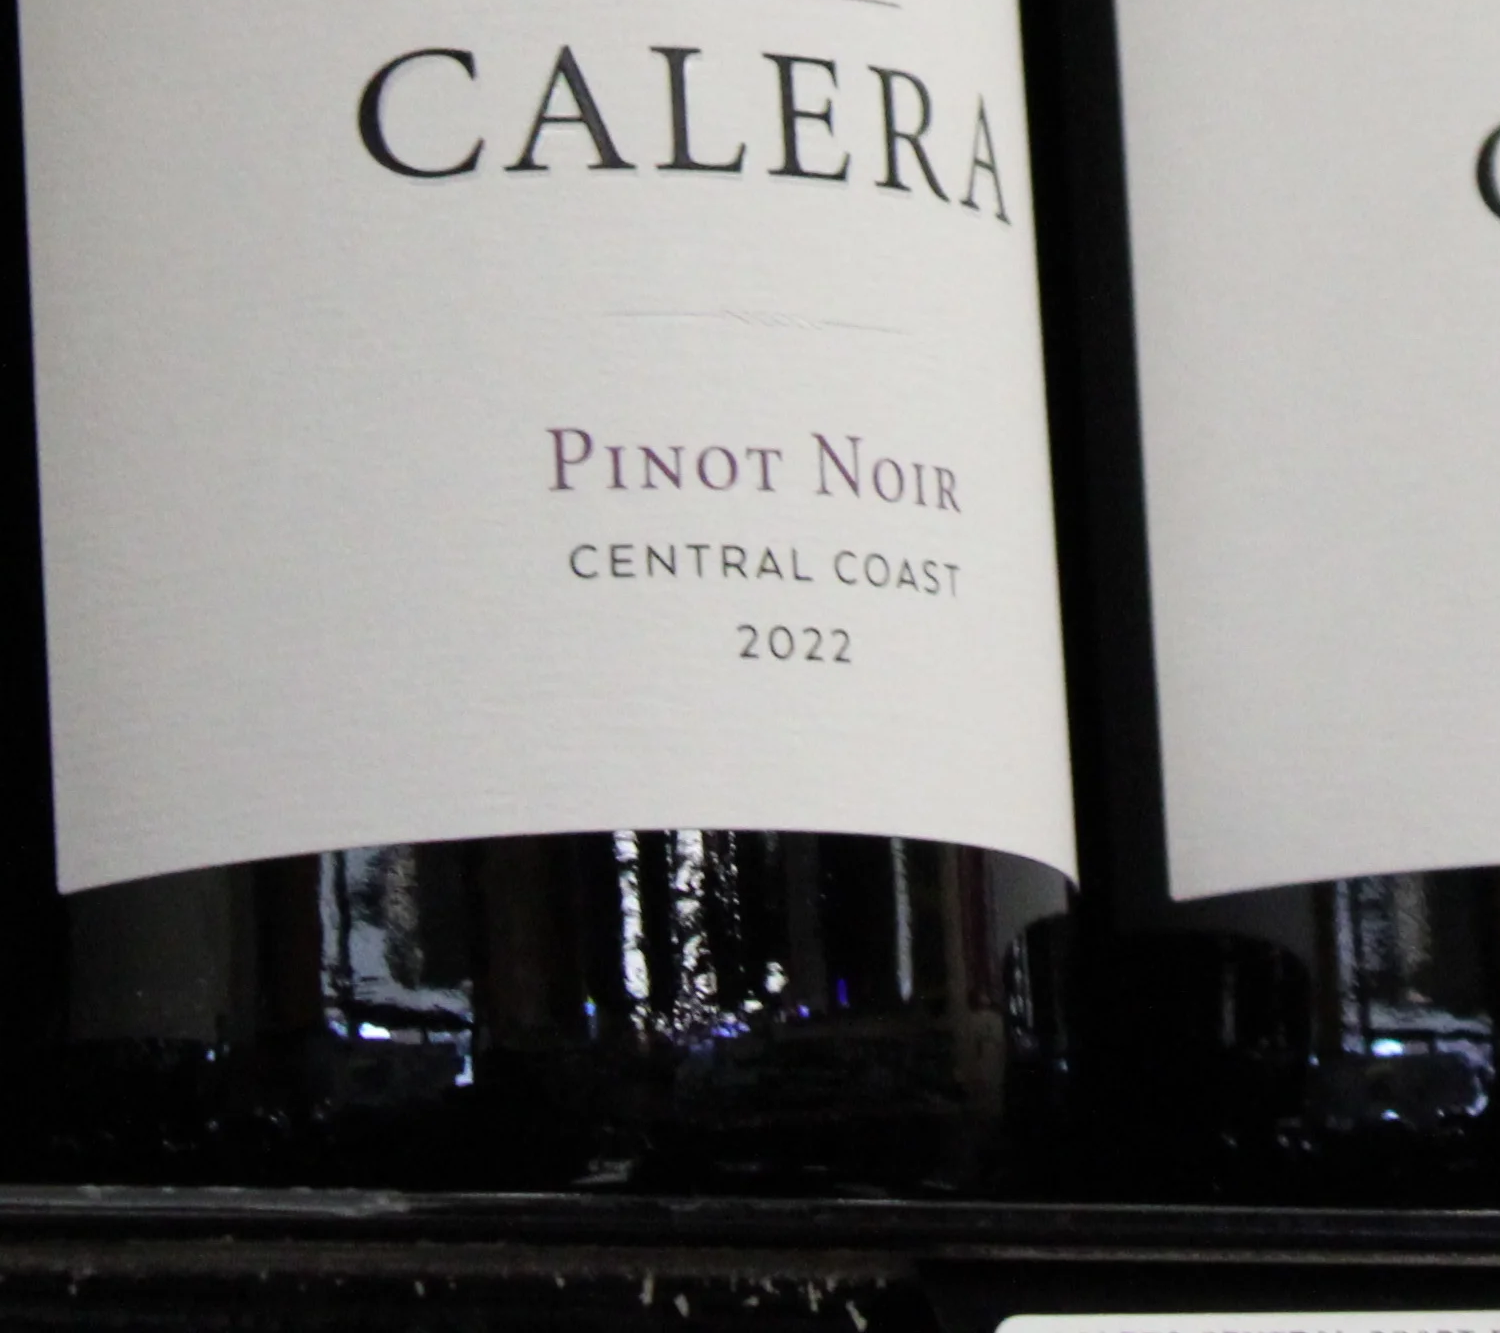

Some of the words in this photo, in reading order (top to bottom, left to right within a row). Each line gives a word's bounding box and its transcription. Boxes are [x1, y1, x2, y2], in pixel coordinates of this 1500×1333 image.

[355, 44, 1014, 228] CALERA
[545, 426, 783, 493] PINOT
[811, 431, 963, 515] NOIR
[568, 543, 814, 582] CENTRAL
[832, 549, 961, 598] COAST
[736, 624, 853, 664] 2022
